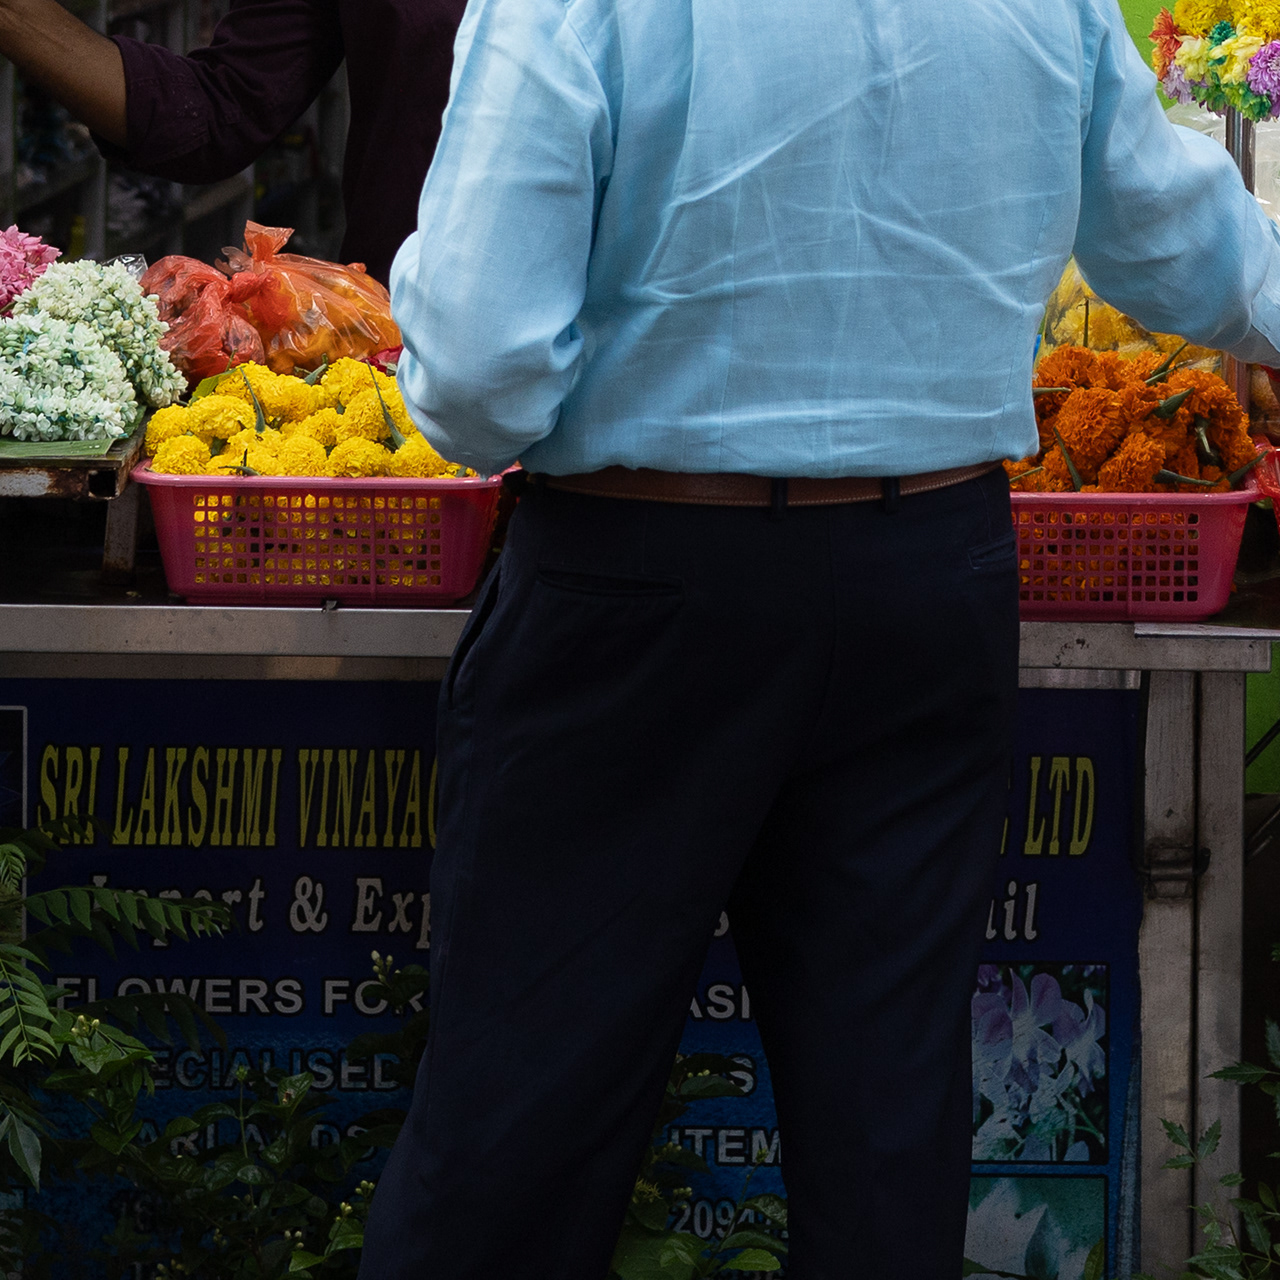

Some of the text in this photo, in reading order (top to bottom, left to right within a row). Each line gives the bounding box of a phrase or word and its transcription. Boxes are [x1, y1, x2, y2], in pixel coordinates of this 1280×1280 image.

[37, 743, 102, 846] SRI
[112, 744, 283, 849] LAKSHMI
[1023, 756, 1096, 856] LTD
[92, 874, 266, 947] ort
[289, 876, 328, 932] &
[120, 1051, 402, 1090] ECIALISED
